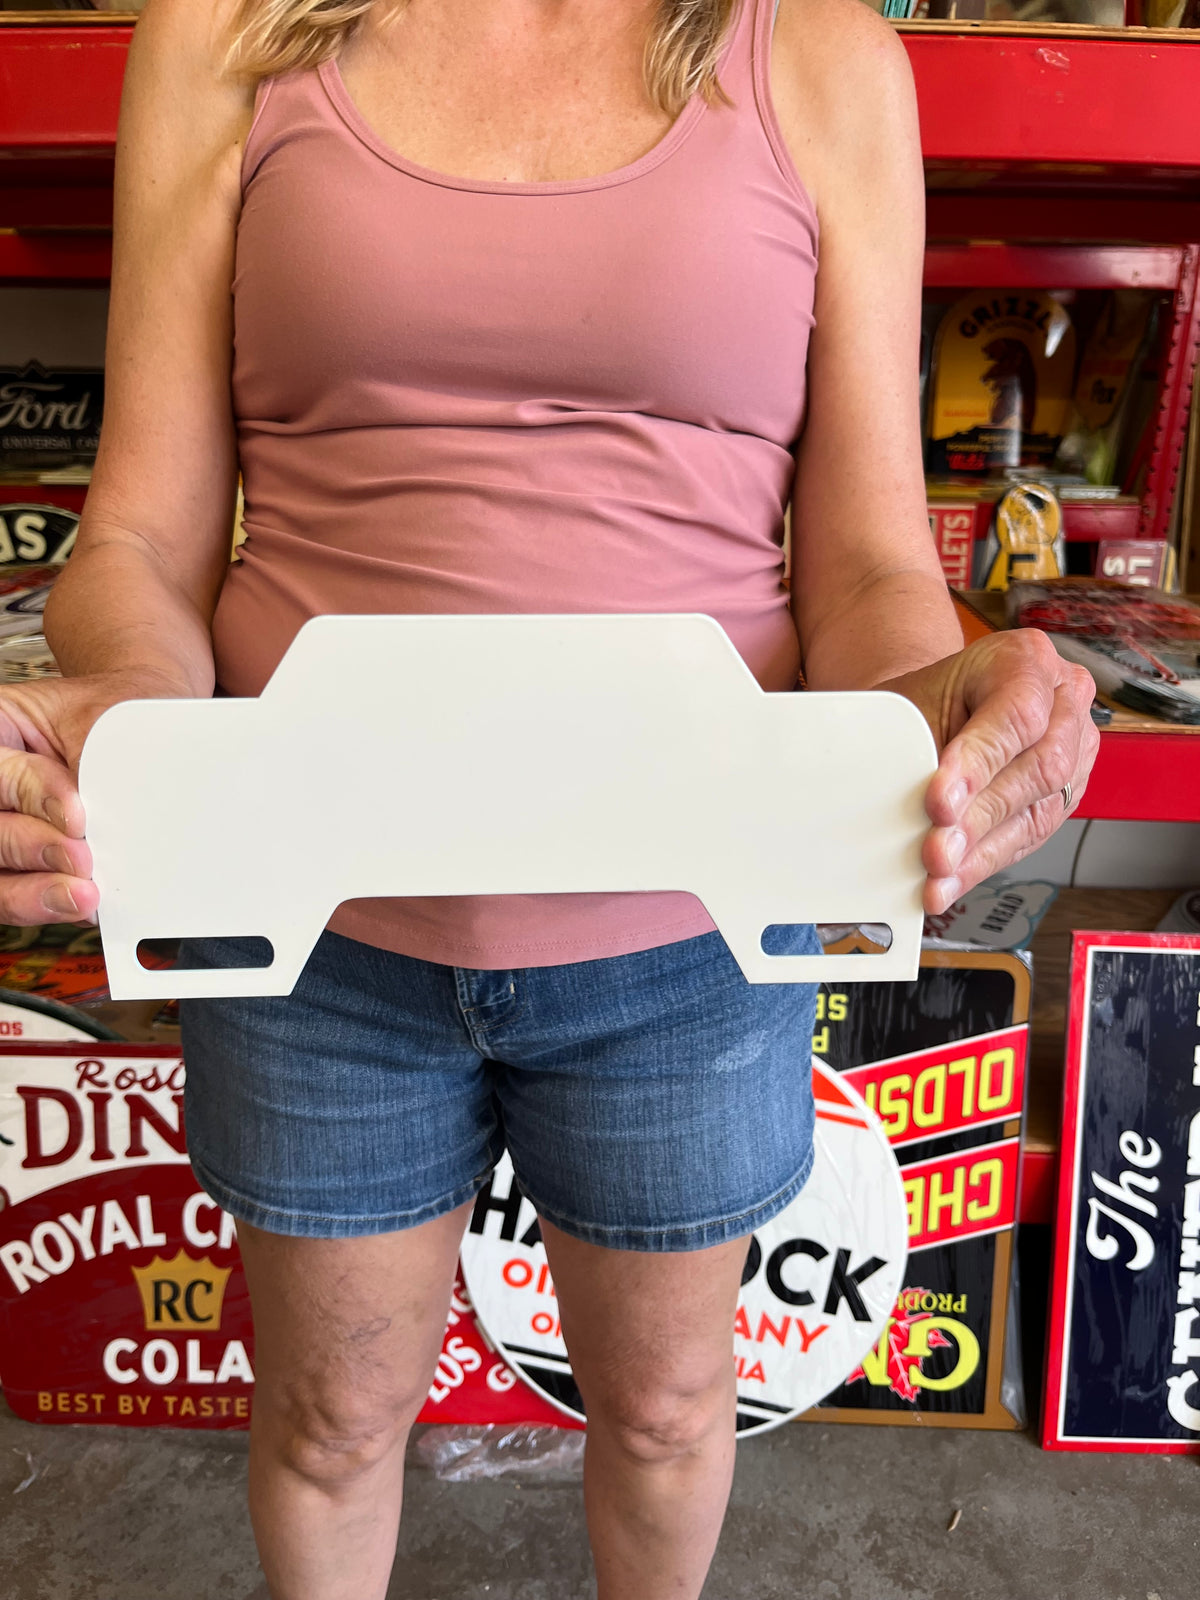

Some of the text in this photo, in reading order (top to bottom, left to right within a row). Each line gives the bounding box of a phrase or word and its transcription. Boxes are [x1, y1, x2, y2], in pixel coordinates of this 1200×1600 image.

[0, 381, 91, 430] Ford
[75, 1059, 186, 1092] Rosi
[16, 1085, 188, 1169] DIN
[904, 1158, 1003, 1237] CHE
[1086, 1129, 1162, 1271] The
[0, 1194, 167, 1294] ROYAL
[153, 1279, 214, 1324] RC
[102, 1337, 256, 1385] COLA
[37, 1391, 249, 1418] BEST BY TASTE
